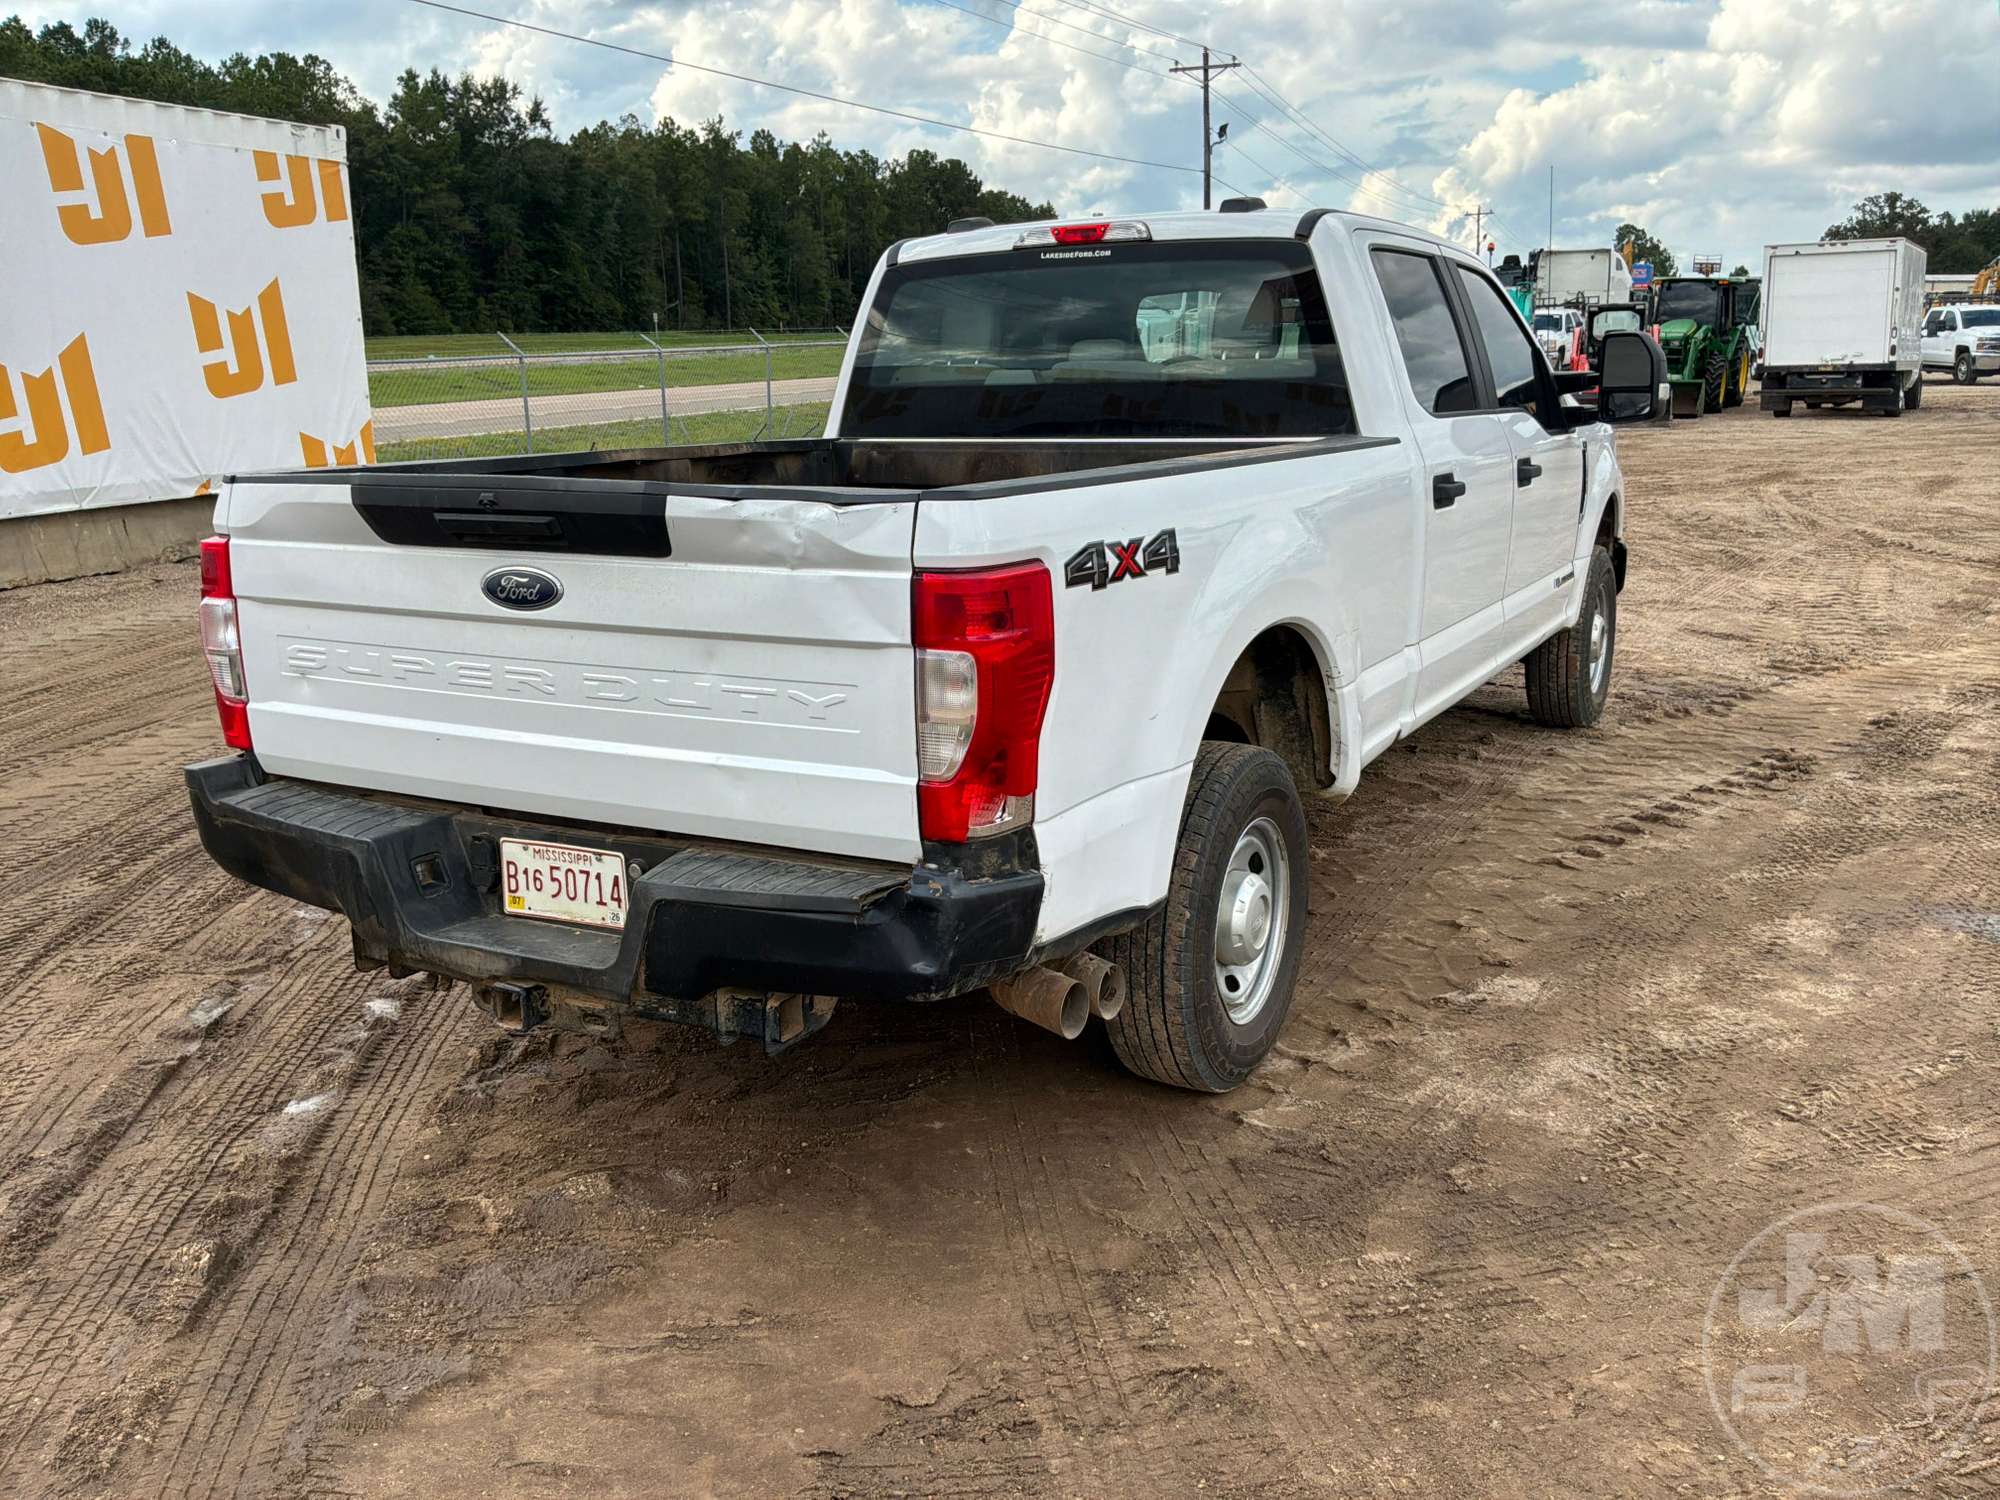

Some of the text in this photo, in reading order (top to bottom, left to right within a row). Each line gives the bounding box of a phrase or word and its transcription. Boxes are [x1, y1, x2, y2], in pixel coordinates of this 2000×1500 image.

[497, 575, 540, 601] Ford
[287, 644, 847, 720] SUPER DUTY
[532, 847, 593, 867] MISSISSIPPI
